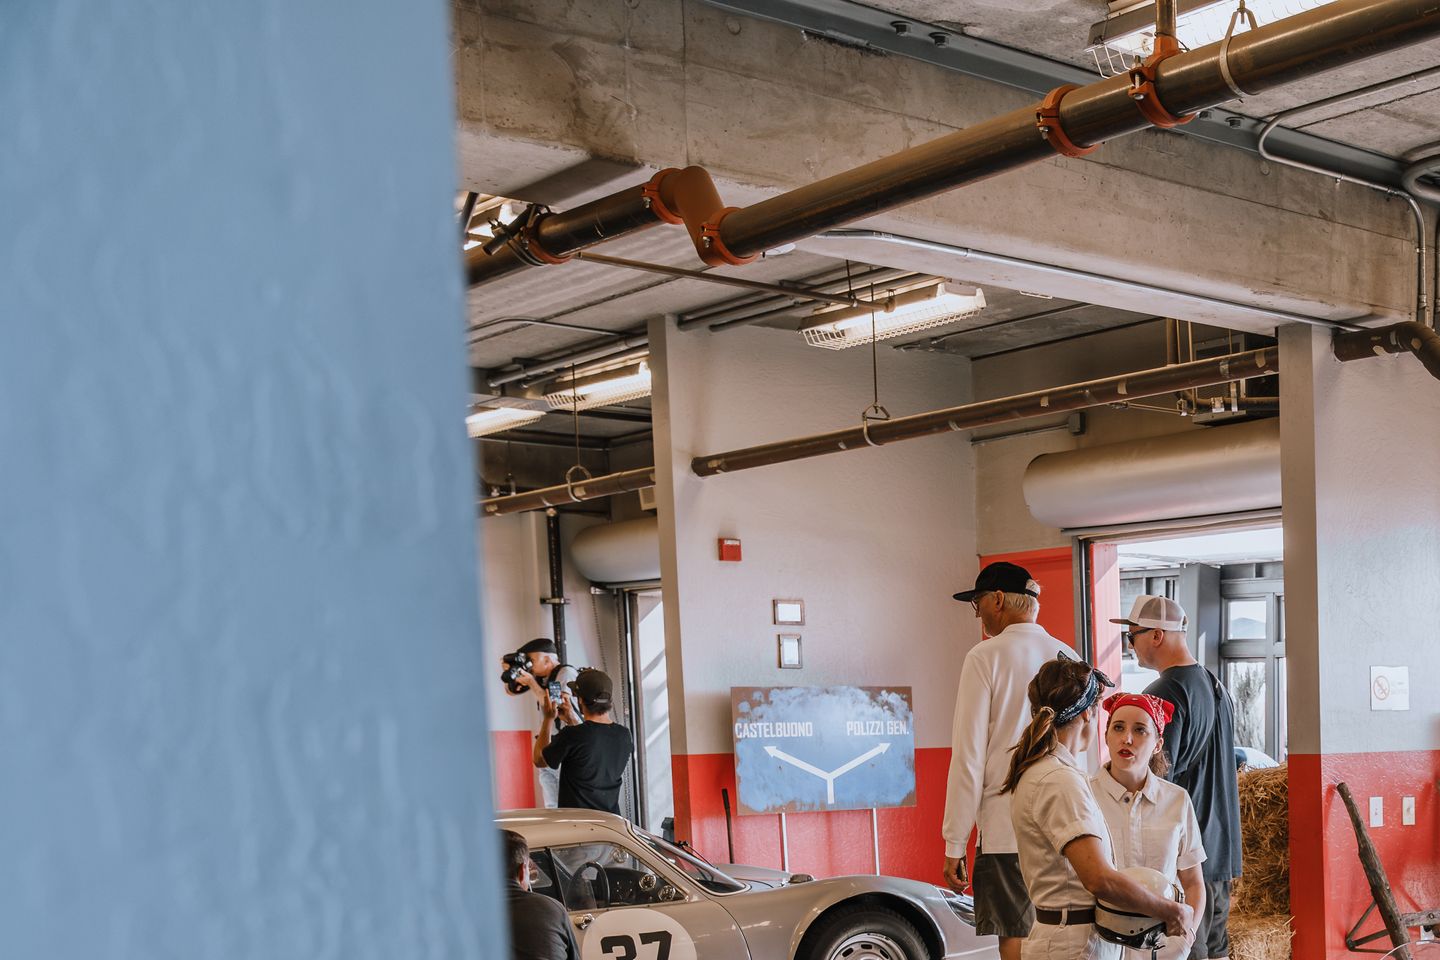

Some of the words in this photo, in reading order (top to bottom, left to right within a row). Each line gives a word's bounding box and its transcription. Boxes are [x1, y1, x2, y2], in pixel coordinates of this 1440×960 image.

[735, 722, 813, 738] CASTELBUONO
[846, 721, 883, 736] POLIZZI
[886, 721, 909, 736] GEN.
